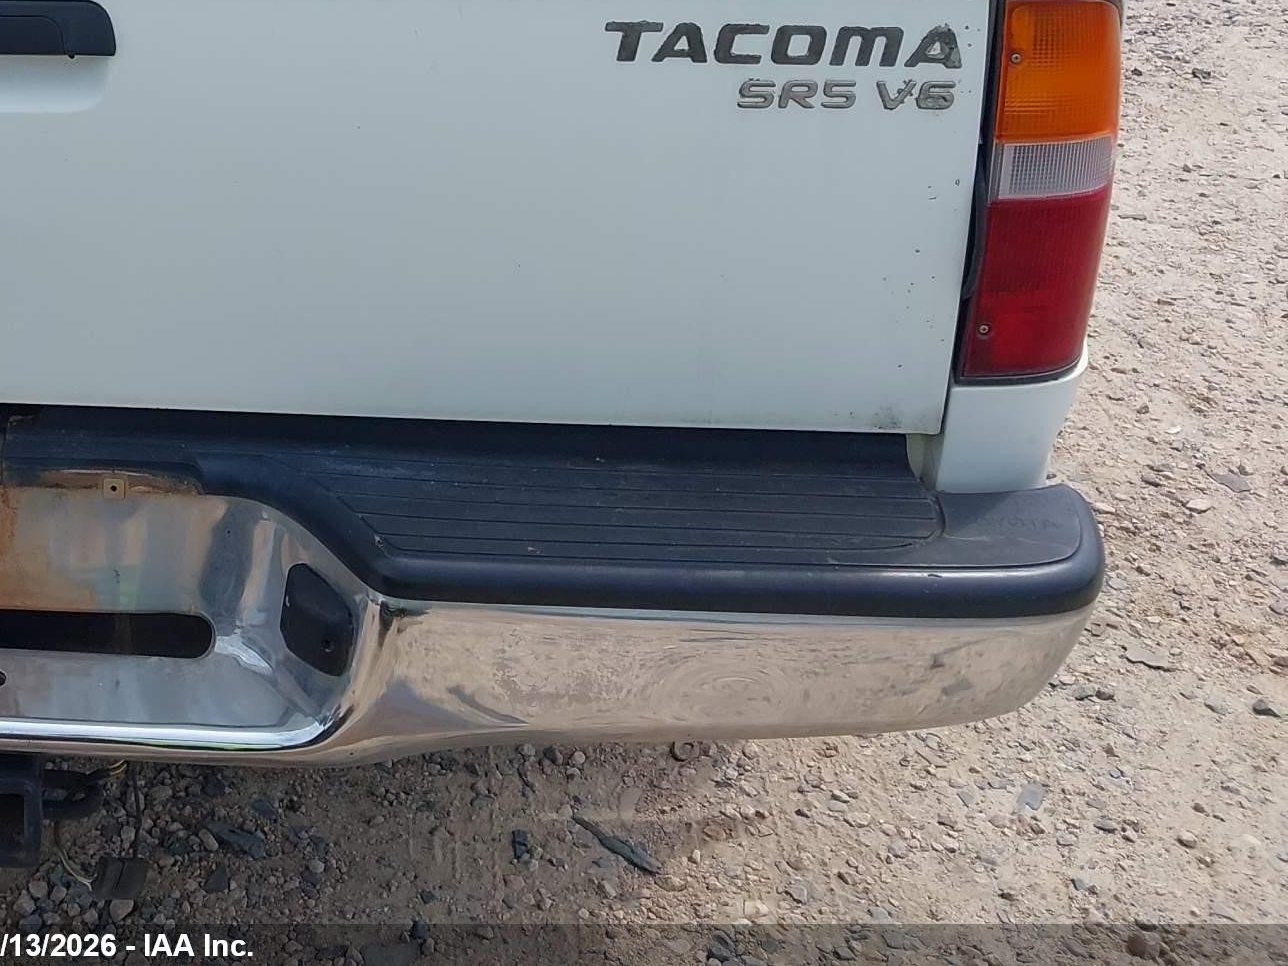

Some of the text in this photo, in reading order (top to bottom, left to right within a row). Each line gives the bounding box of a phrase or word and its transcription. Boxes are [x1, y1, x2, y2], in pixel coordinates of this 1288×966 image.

[605, 20, 962, 69] TACOMA
[736, 78, 956, 111] SR5 V6
